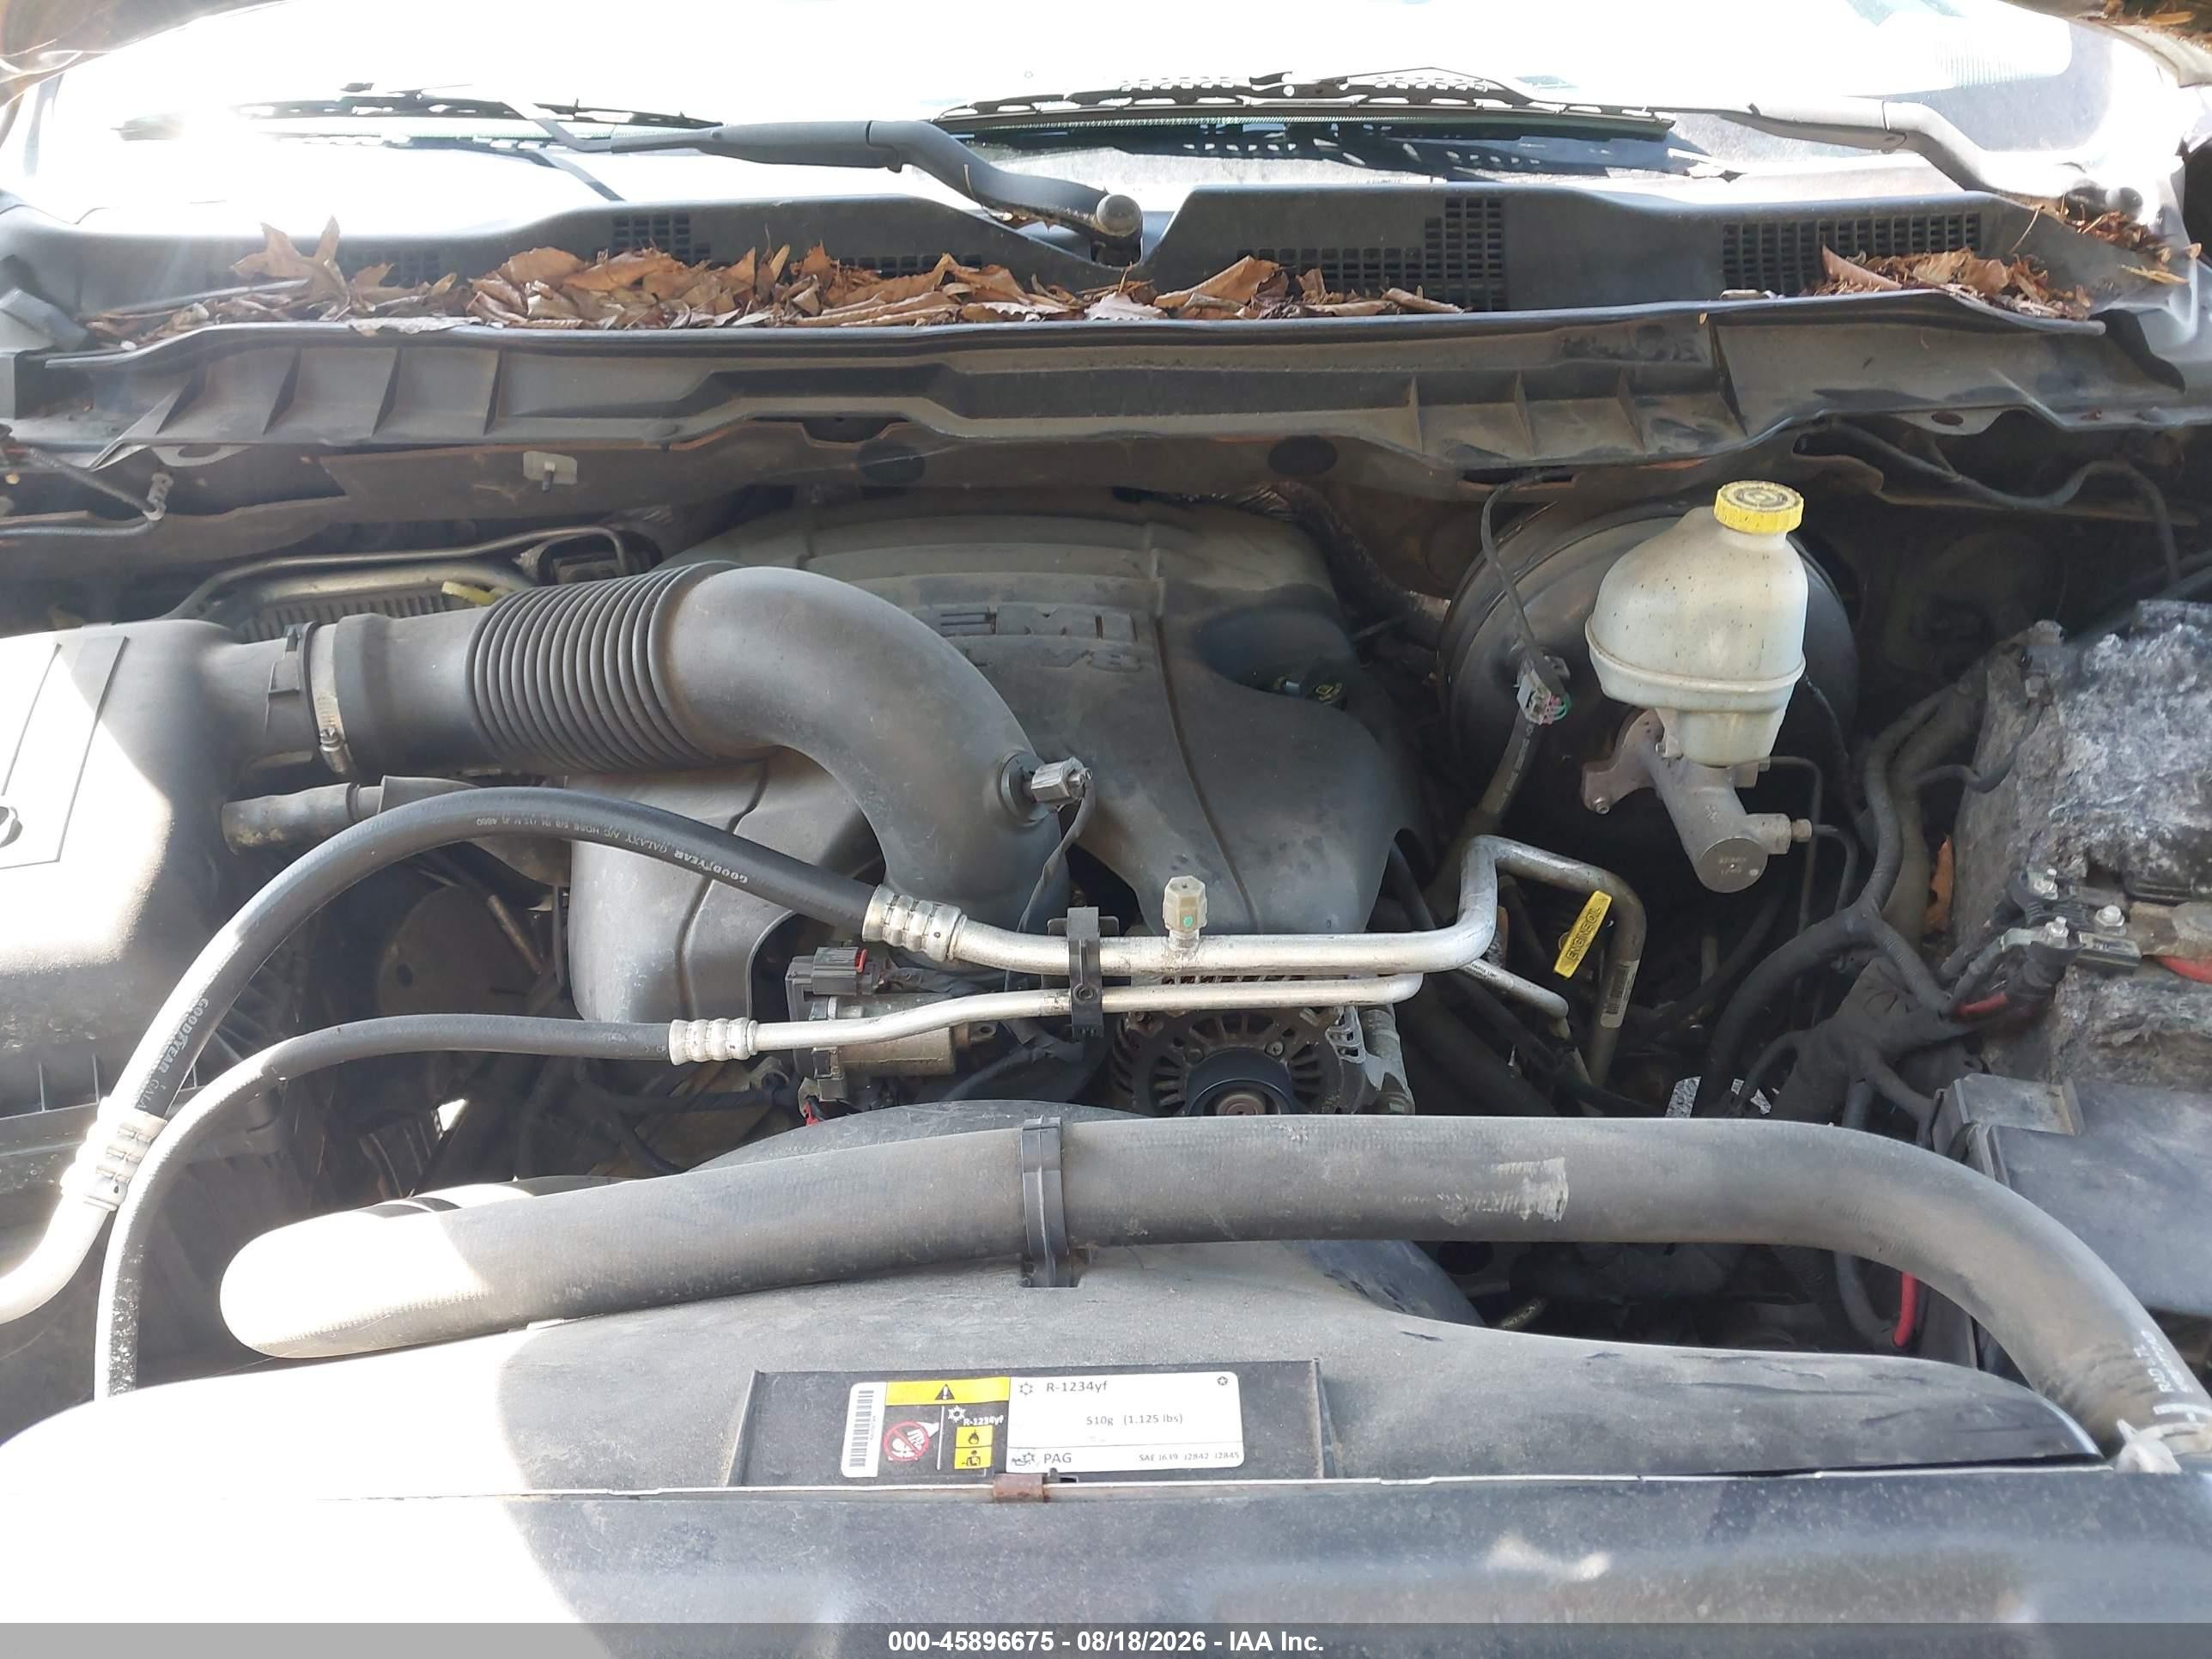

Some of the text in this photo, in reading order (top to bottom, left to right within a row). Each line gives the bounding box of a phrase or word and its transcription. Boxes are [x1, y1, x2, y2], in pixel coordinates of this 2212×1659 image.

[604, 826, 620, 840] A/C
[625, 830, 667, 854] GALAXY
[674, 850, 749, 884] GOODYEAR
[1566, 907, 1602, 960] ENGINE OIL
[137, 998, 210, 1109] GOODYEAR GALA
[1046, 1381, 1109, 1394] R-1234yf
[1085, 1413, 1184, 1426] 510g (1.125 lbs)
[1042, 1452, 1073, 1464] PAG
